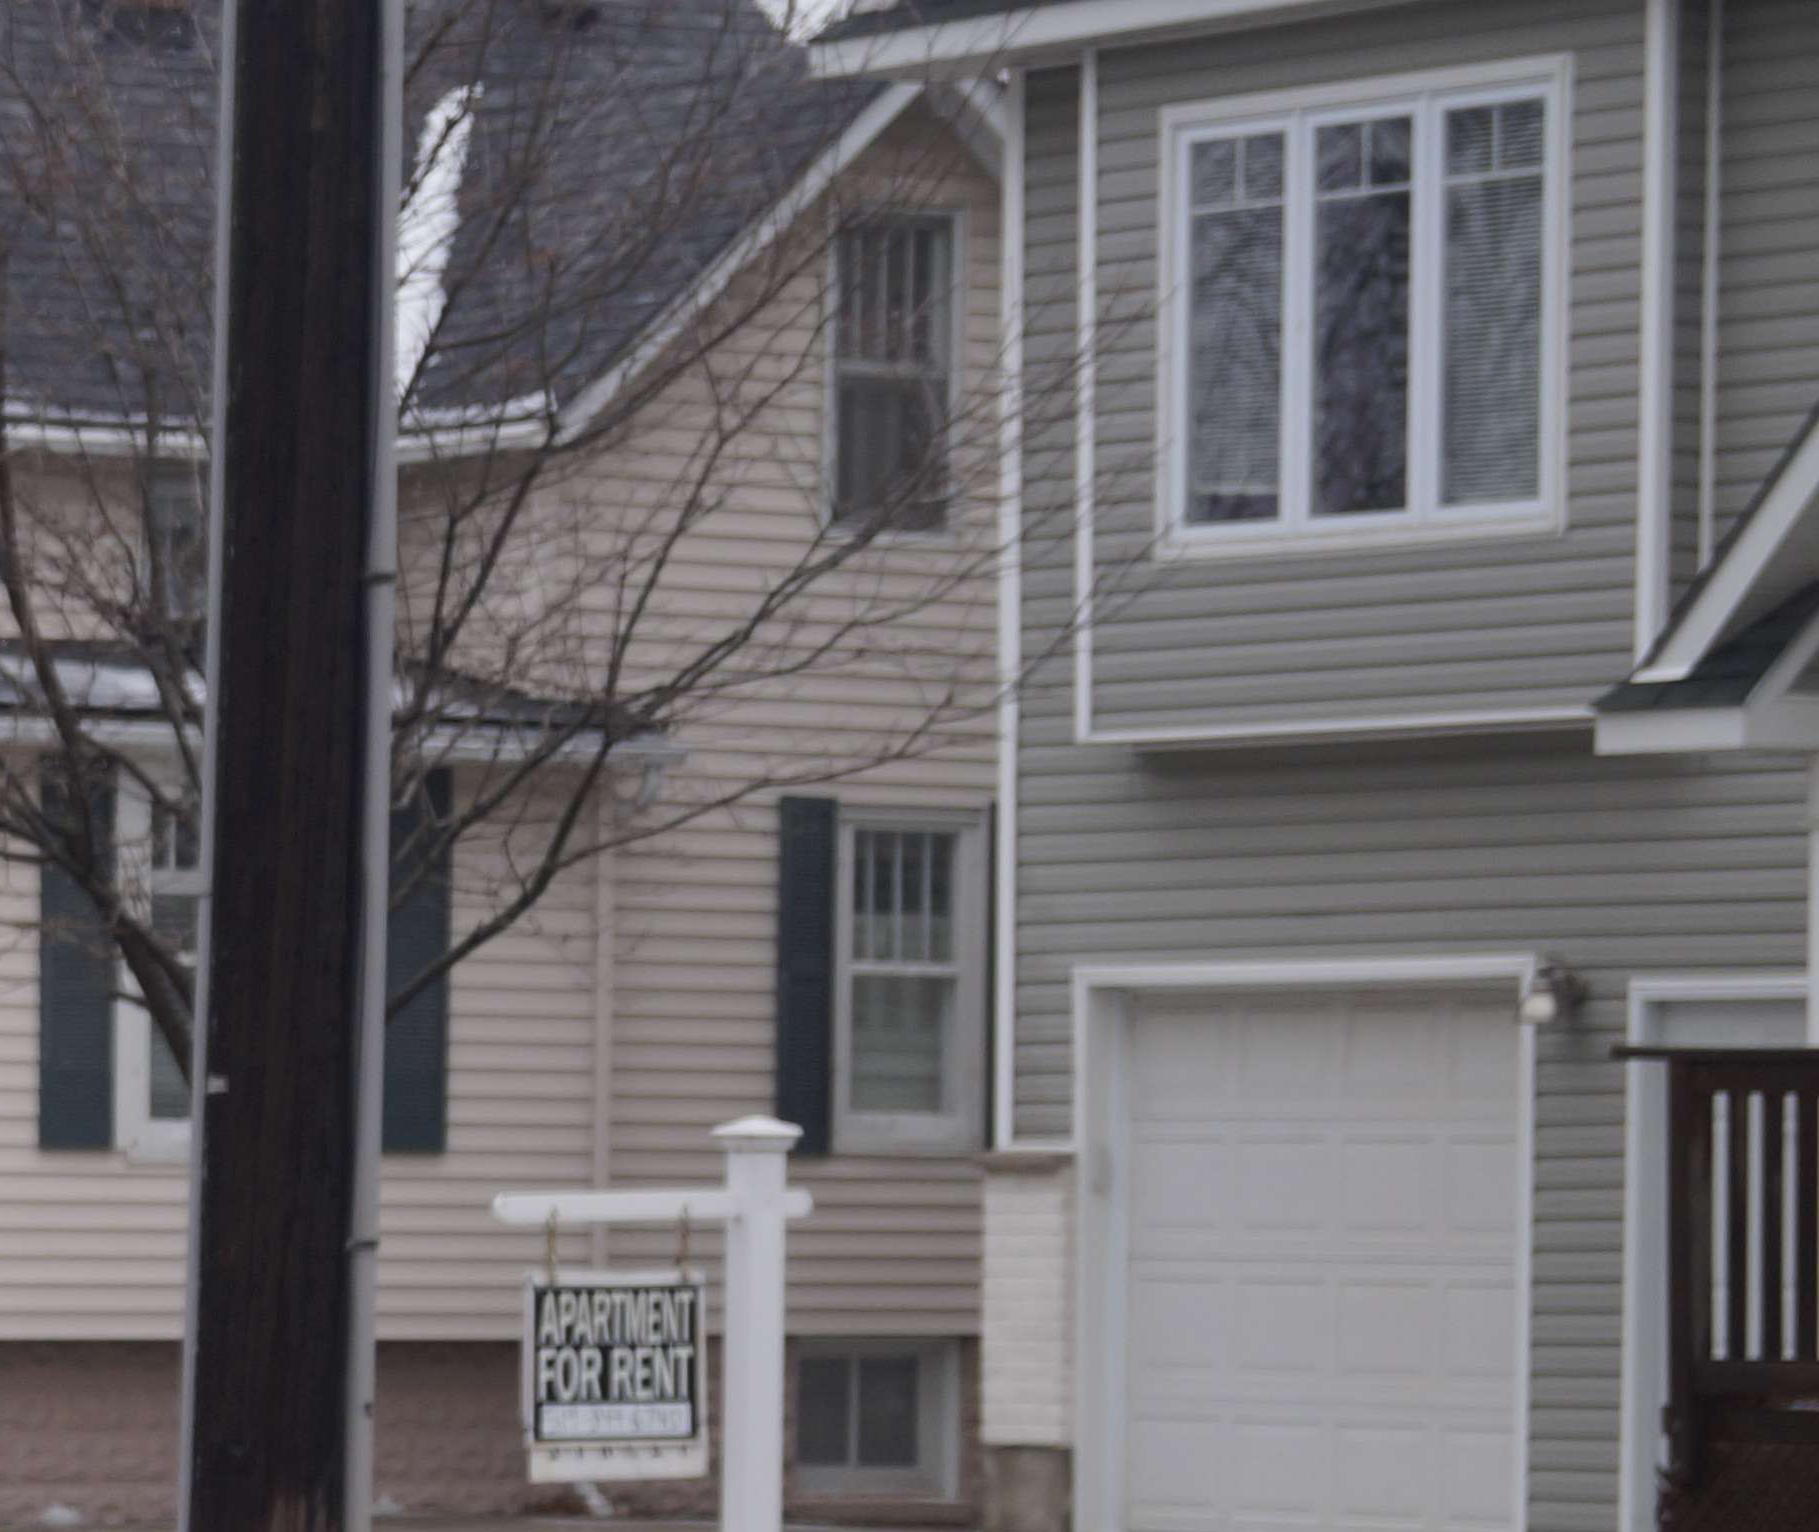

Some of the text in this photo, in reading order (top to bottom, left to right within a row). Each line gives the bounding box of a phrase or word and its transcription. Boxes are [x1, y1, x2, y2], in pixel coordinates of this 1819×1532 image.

[538, 1288, 694, 1345] APARTMENT
[537, 1346, 694, 1402] FOR RENT
